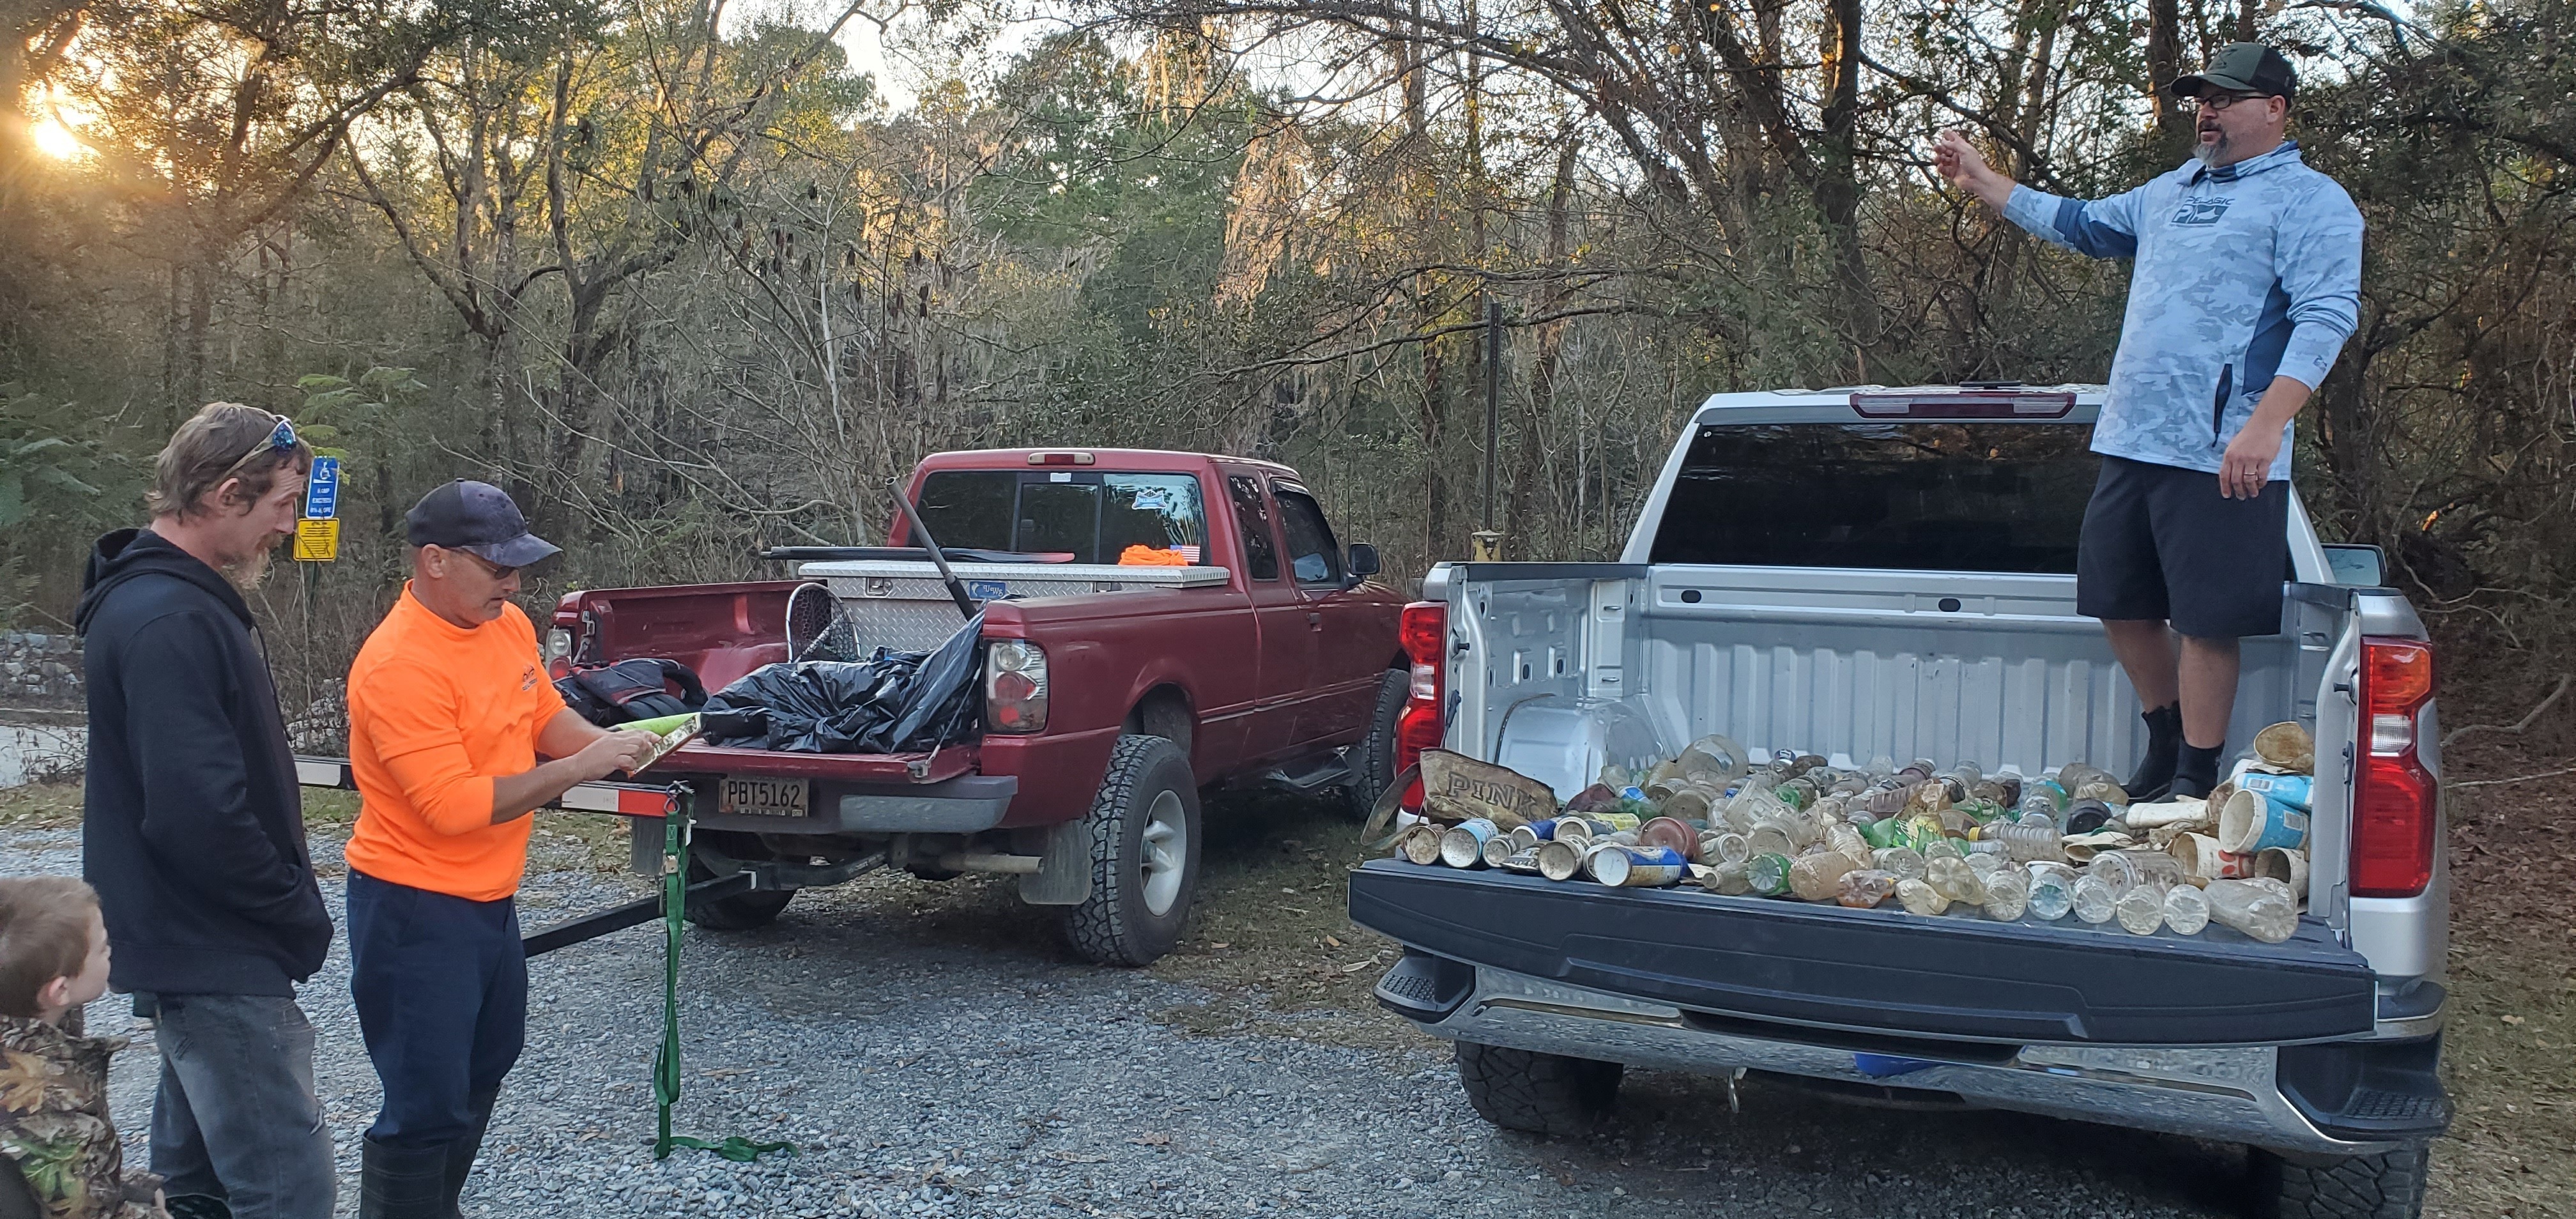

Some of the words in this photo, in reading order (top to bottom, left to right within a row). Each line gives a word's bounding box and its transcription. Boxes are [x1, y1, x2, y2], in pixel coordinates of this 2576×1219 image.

[2185, 195, 2235, 205] PELAGIC
[983, 585, 1003, 597] UWS
[728, 781, 800, 808] PBT5162
[1446, 770, 1537, 822] PINK
